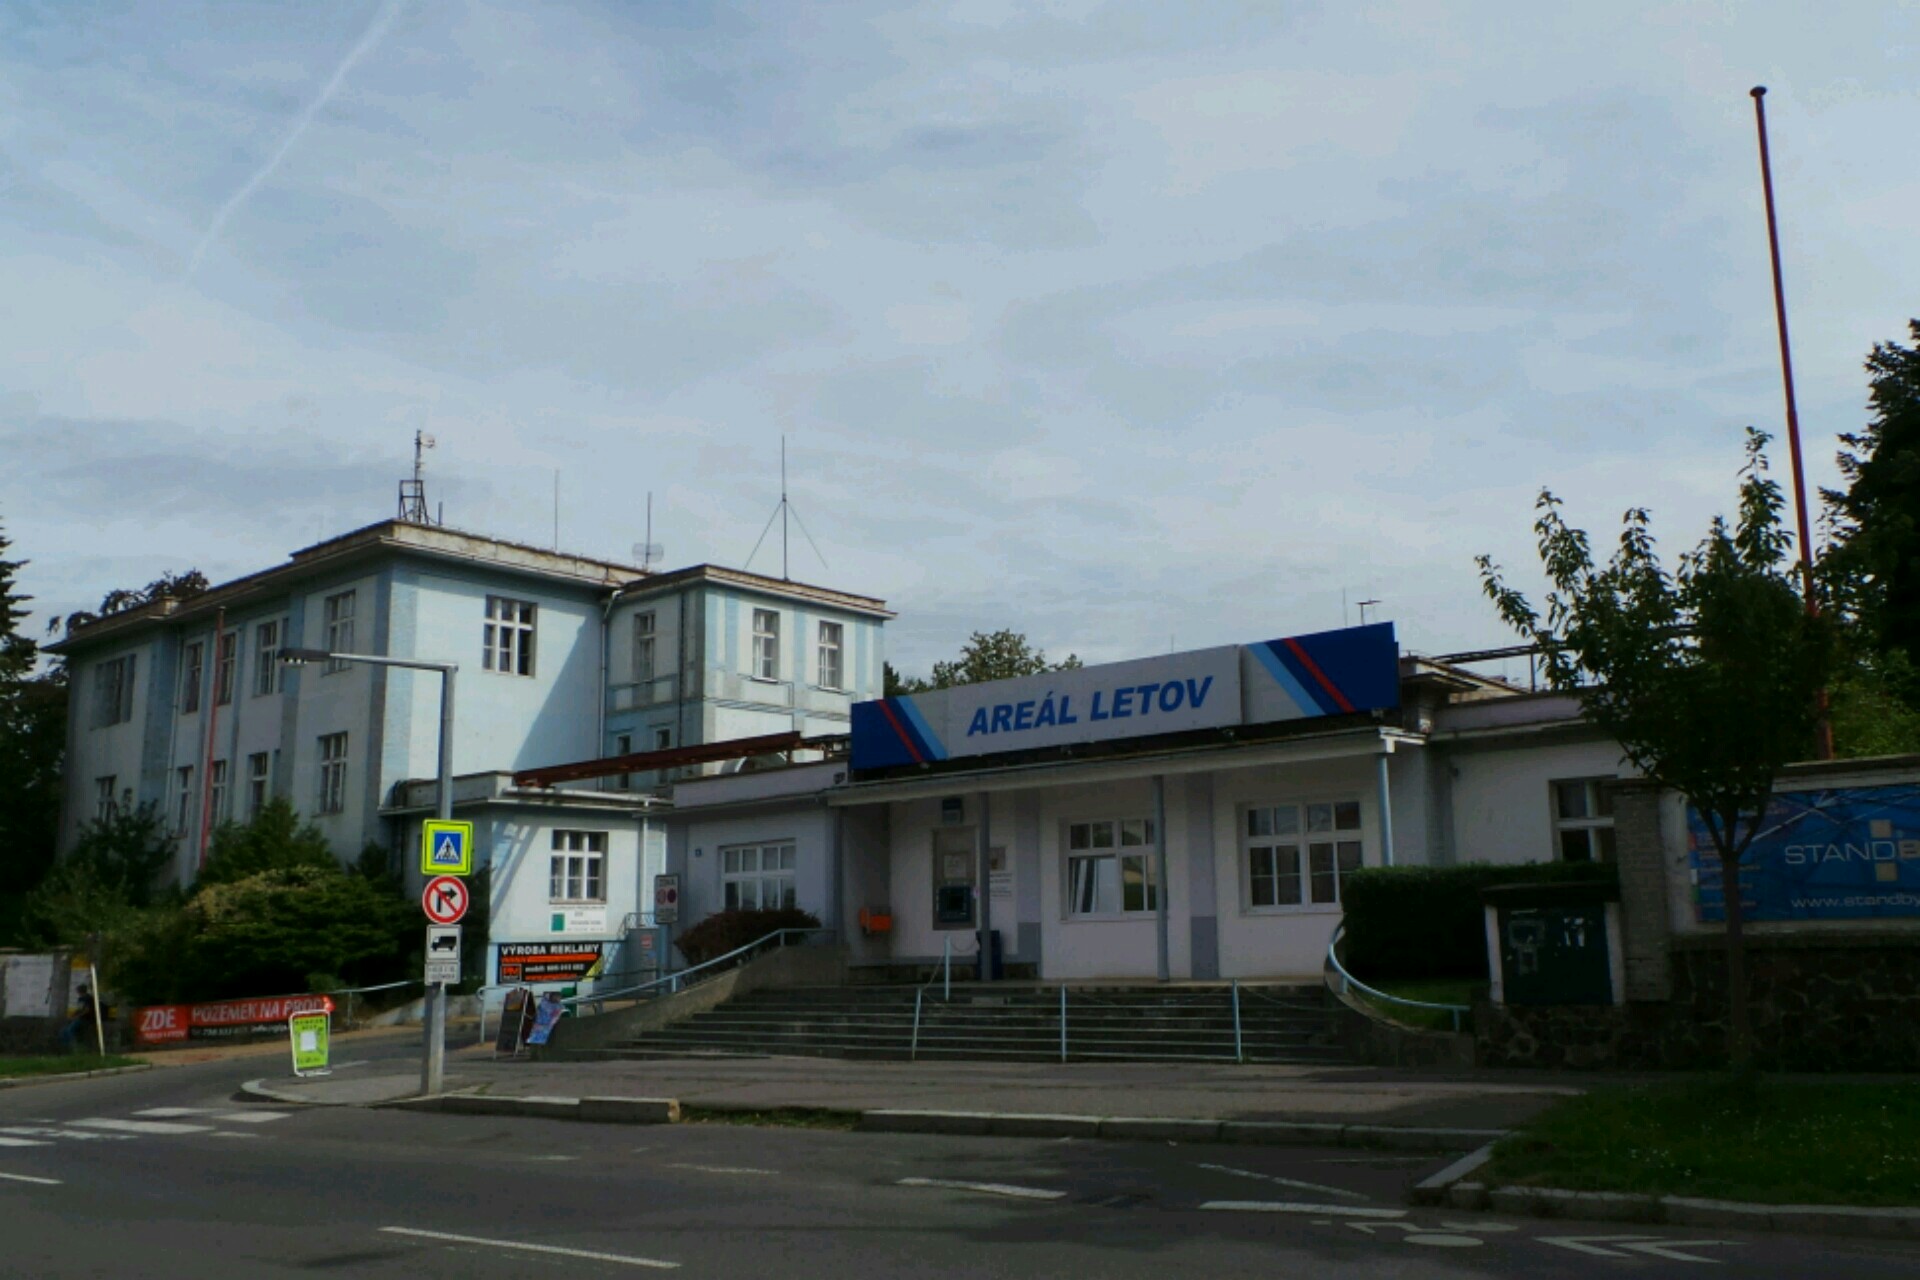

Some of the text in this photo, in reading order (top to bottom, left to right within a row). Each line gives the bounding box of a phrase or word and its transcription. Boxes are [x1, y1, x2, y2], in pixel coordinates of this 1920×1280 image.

[967, 676, 1214, 736] AREÁL LETOV
[501, 943, 599, 955] VÝROBA REKLAMY
[141, 1009, 176, 1031] ZDE
[192, 1003, 257, 1022] POZEMEK
[259, 1000, 280, 1018] NA
